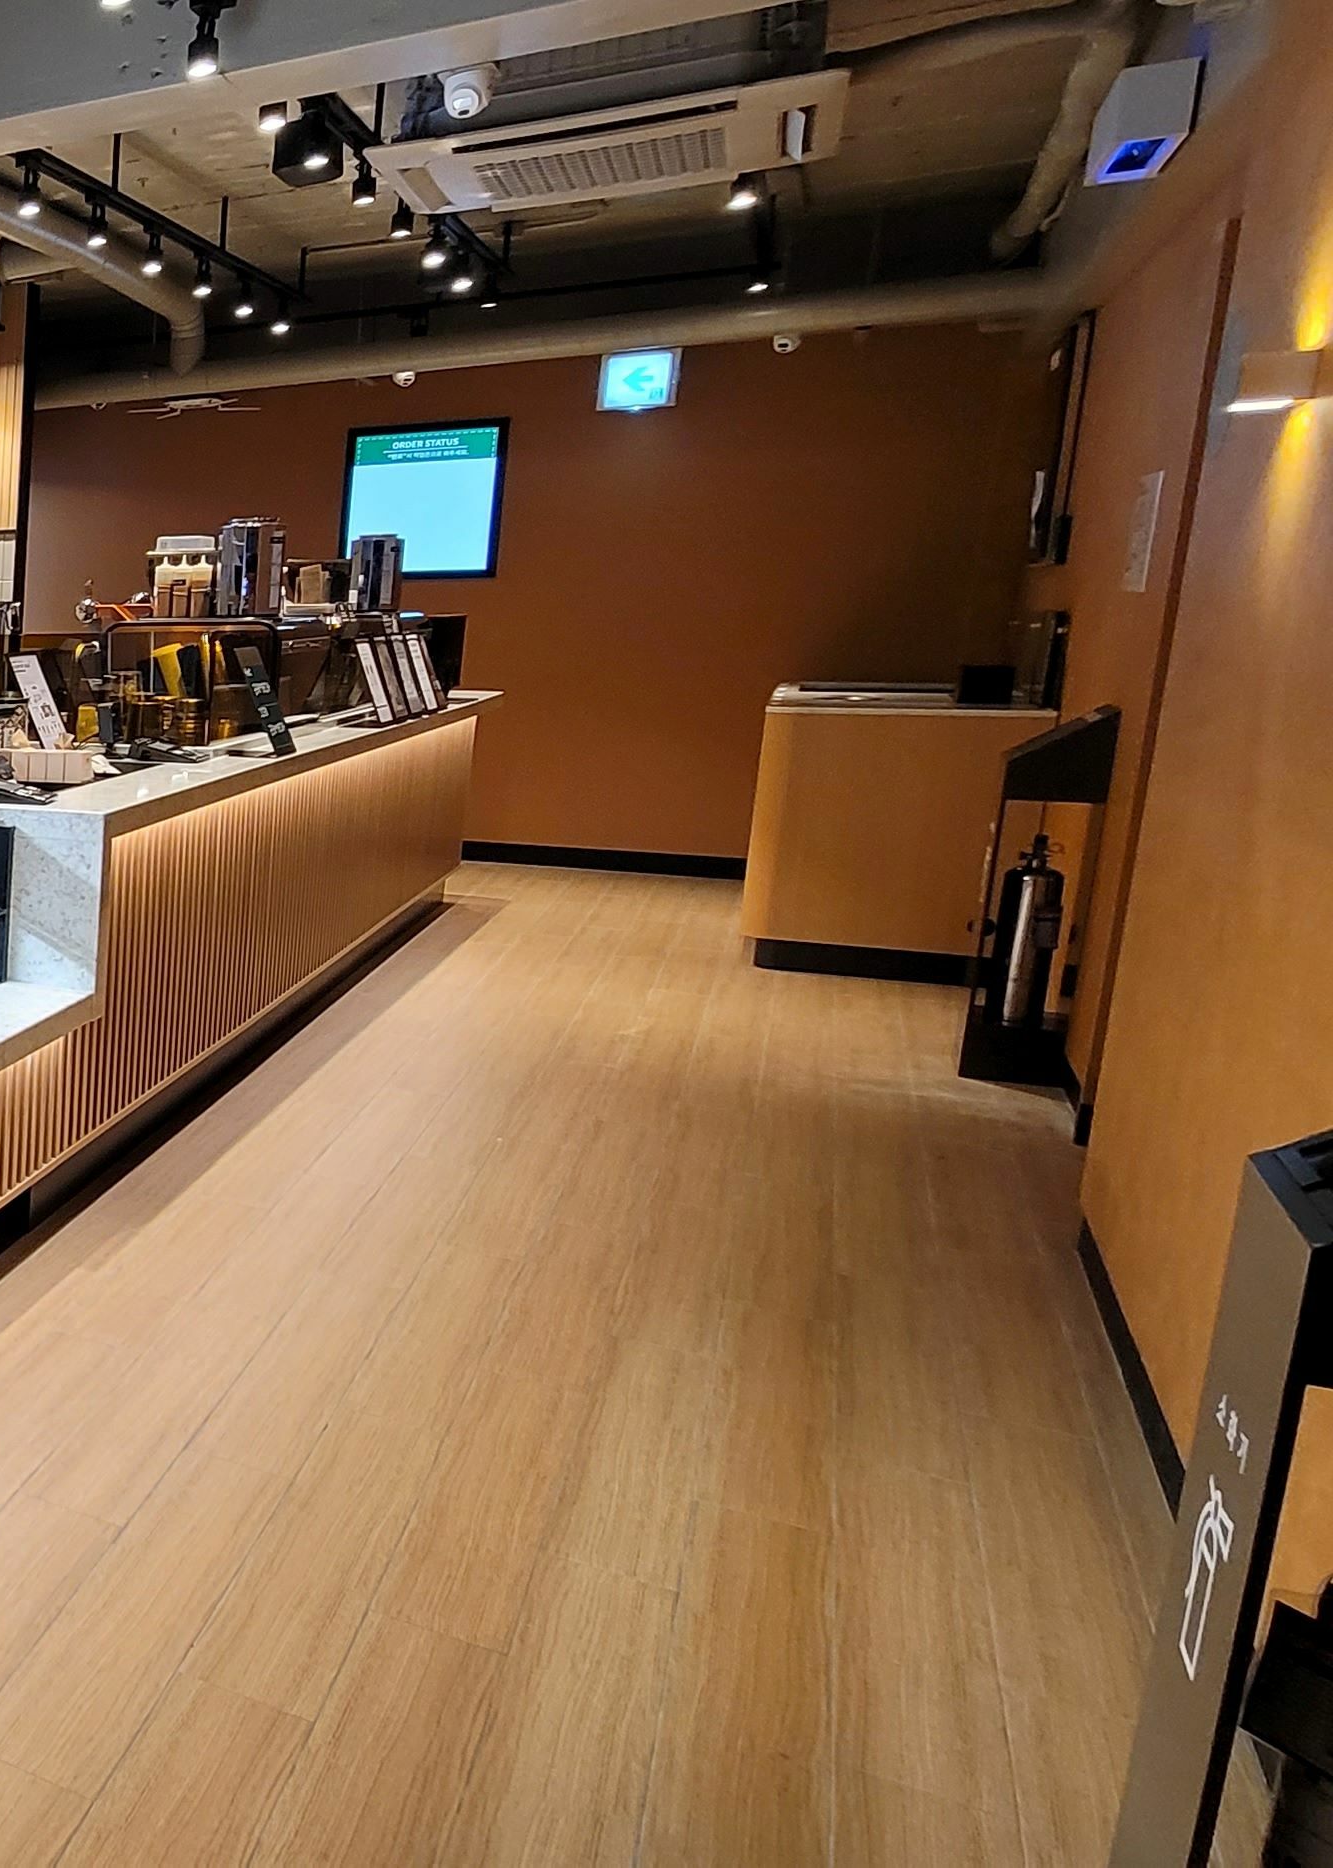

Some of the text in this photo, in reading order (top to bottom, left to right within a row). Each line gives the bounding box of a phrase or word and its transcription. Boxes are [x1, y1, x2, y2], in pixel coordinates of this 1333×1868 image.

[392, 437, 459, 449] ORDER STATUS
[1215, 1394, 1250, 1475] 소화기
